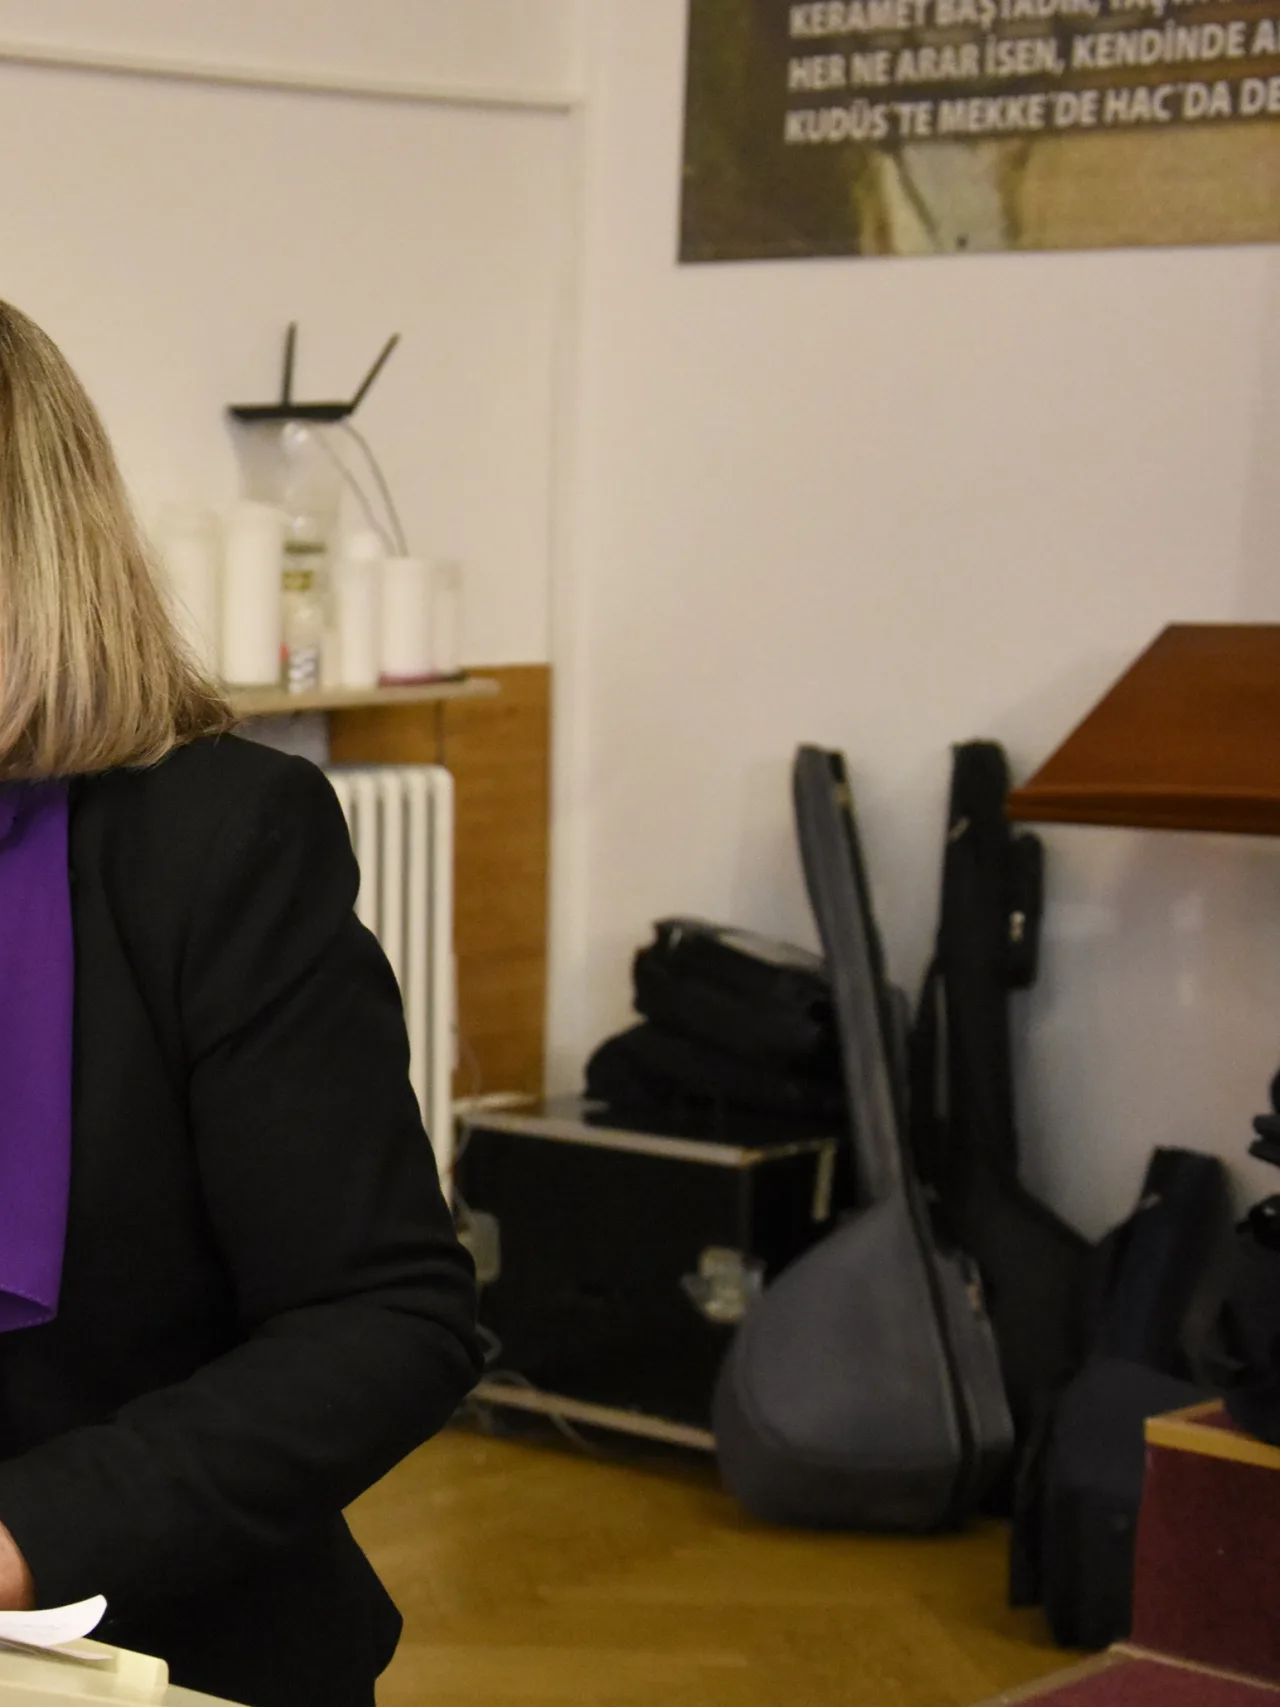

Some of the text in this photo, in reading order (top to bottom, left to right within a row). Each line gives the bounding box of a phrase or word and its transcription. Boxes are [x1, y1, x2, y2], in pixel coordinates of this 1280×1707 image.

[789, 0, 925, 38] KERAMET
[787, 17, 1280, 90] HER NE ARAR İSEN, KENDİNDE A
